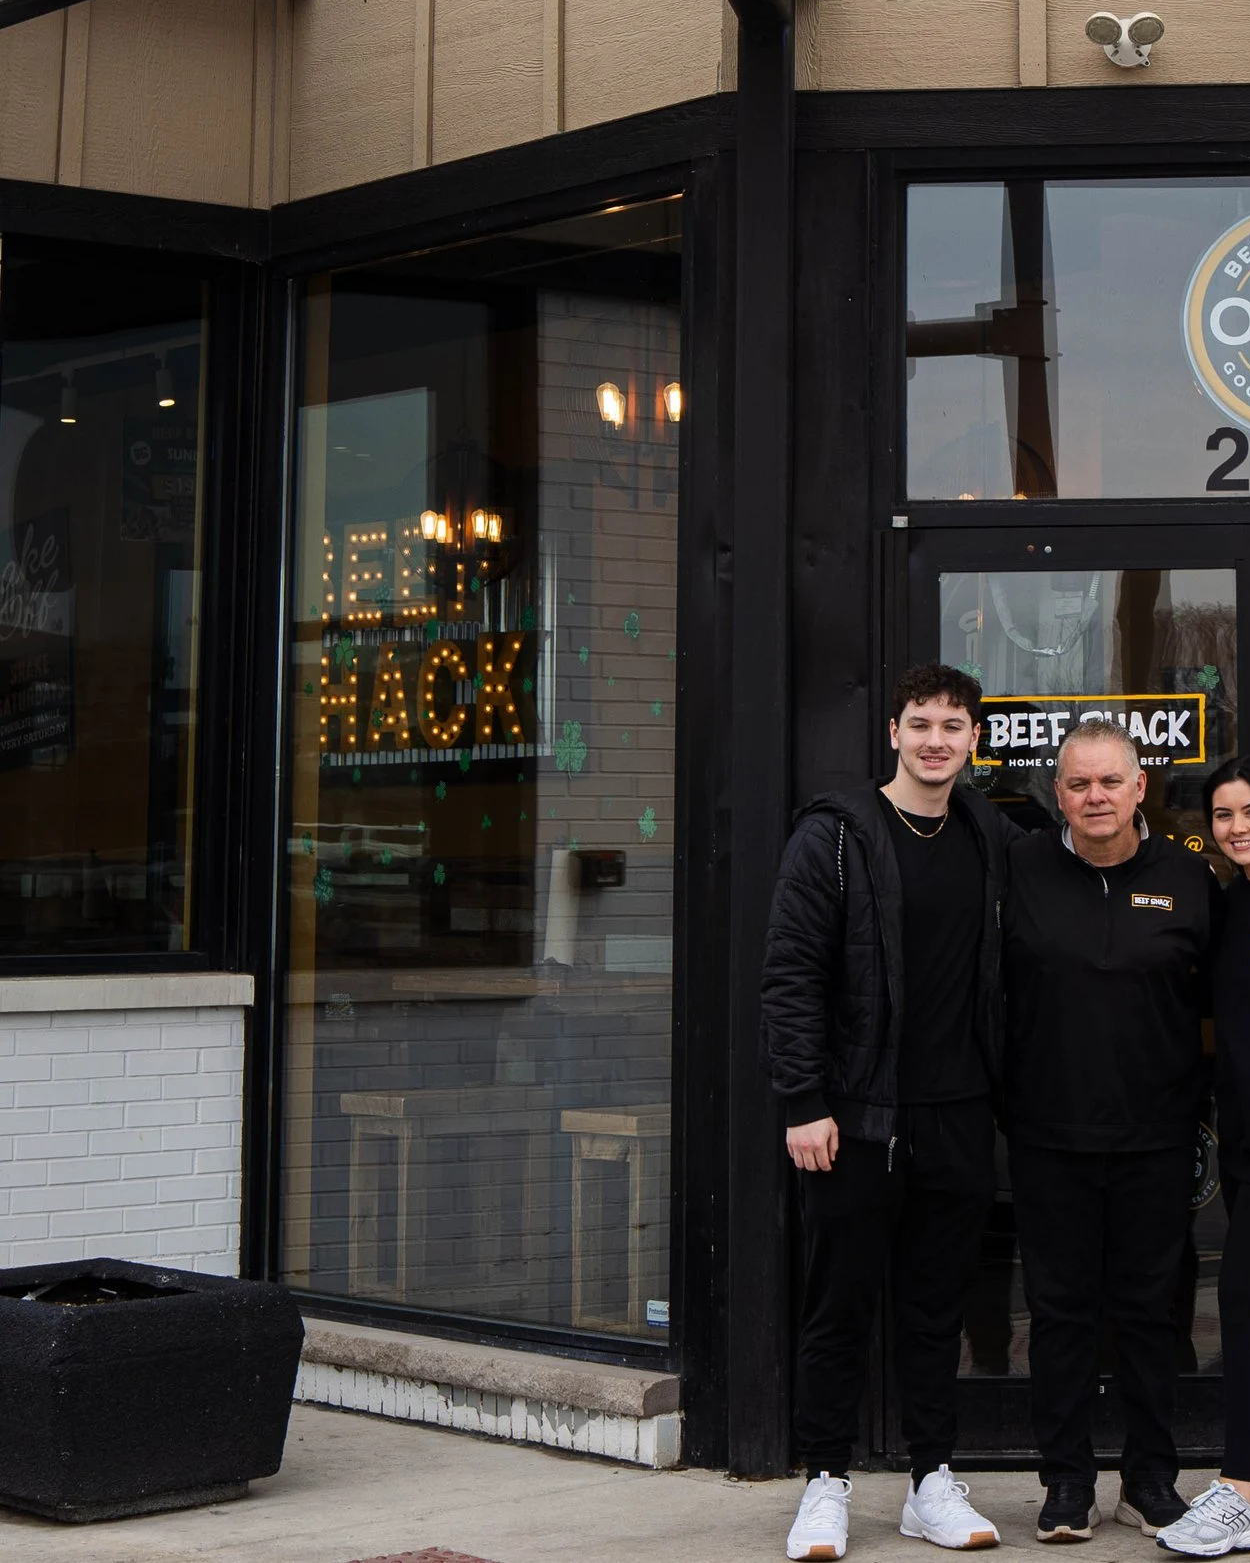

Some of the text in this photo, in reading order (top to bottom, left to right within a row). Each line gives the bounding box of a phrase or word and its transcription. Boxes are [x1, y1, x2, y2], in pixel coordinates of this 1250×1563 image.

[320, 632, 527, 751] HACK
[987, 711, 1071, 748] BEEF
[1008, 758, 1042, 767] HOME
[1140, 756, 1170, 766] BEEF
